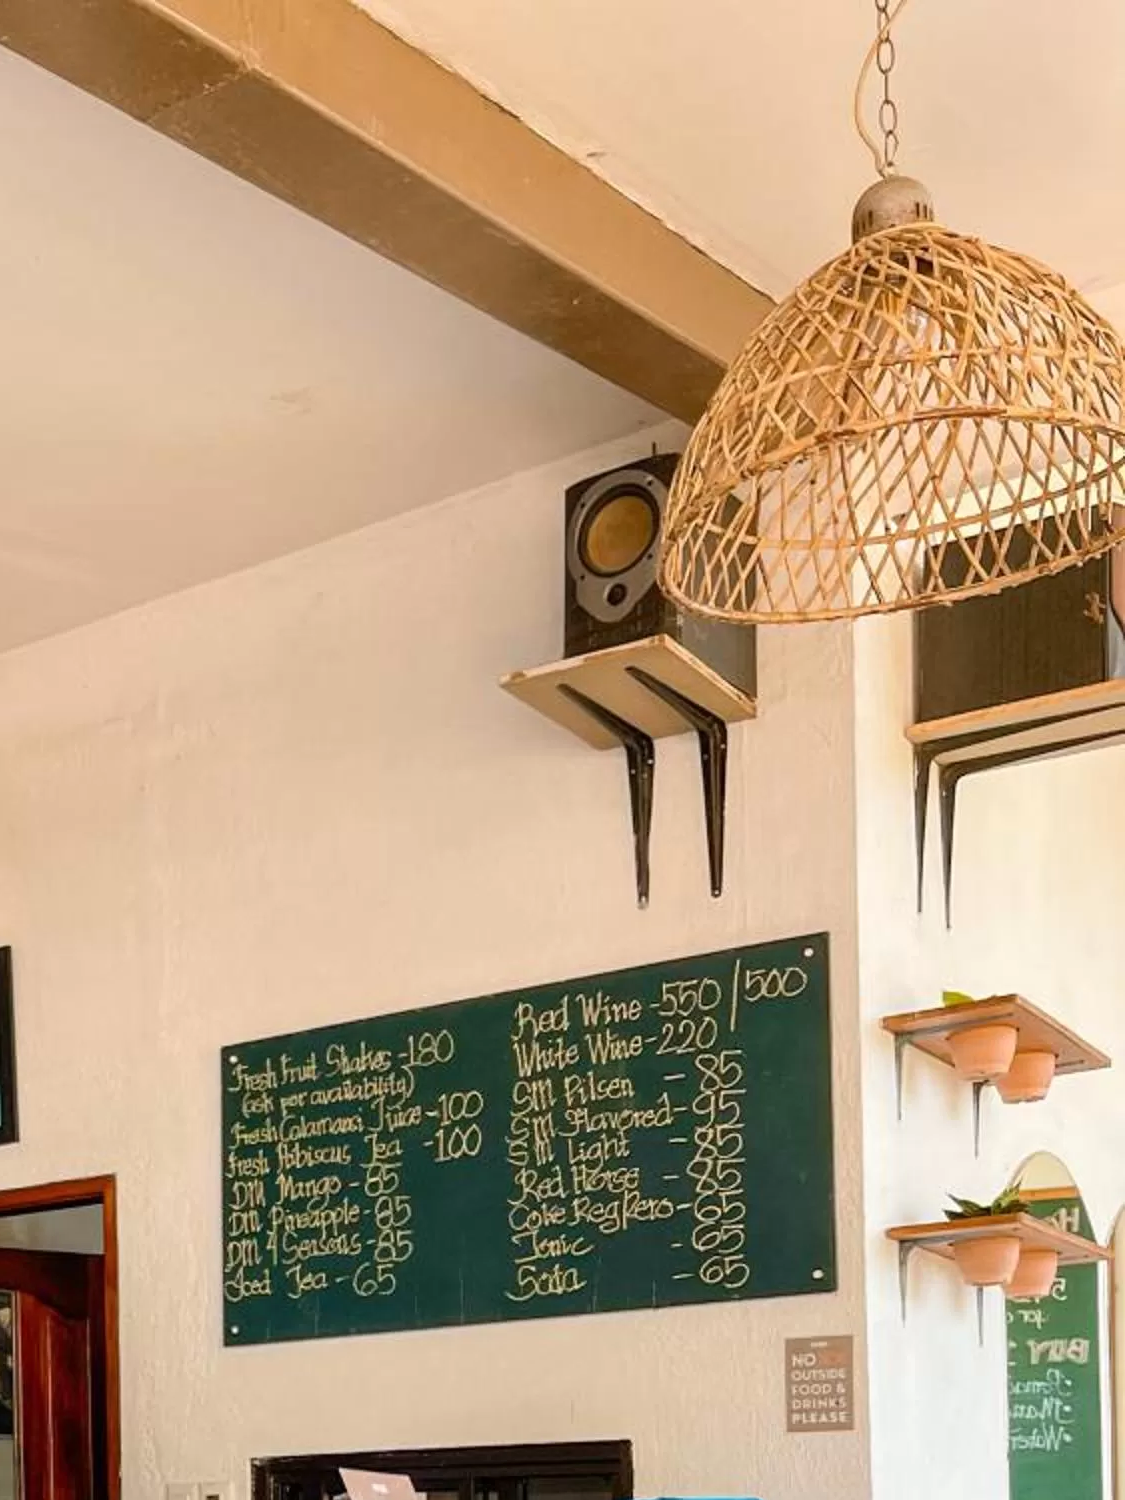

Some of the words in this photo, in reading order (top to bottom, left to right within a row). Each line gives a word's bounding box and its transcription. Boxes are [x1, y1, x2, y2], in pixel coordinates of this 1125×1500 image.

[512, 994, 570, 1038] Red
[576, 990, 643, 1027] Wine
[227, 1057, 277, 1092] Fresh
[280, 1052, 321, 1087] Fruit
[325, 1041, 392, 1077] Shakes
[510, 1037, 580, 1077] White
[585, 1029, 643, 1065] Wine
[563, 1072, 636, 1109] Pilsen
[228, 1117, 277, 1150] Fresh
[368, 1096, 422, 1133] Juice
[558, 1092, 674, 1137] Flavored
[226, 1149, 270, 1178] Fresh
[364, 1132, 403, 1166] Tea
[568, 1131, 630, 1170] Light
[275, 1172, 342, 1211] Mango
[507, 1166, 568, 1205] Red
[571, 1165, 639, 1195] Horse
[267, 1198, 361, 1237] Pineapple
[508, 1201, 566, 1232] Coke
[281, 1229, 361, 1264] Seasons
[511, 1229, 595, 1264] Tonic
[224, 1266, 272, 1303] Iced
[285, 1264, 328, 1300] Tea
[791, 1368, 846, 1381] OUTSIDE
[792, 1353, 816, 1367] NO
[791, 1383, 832, 1396] FOOD
[792, 1396, 847, 1409] DRINKS
[792, 1411, 847, 1424] PLEASE
